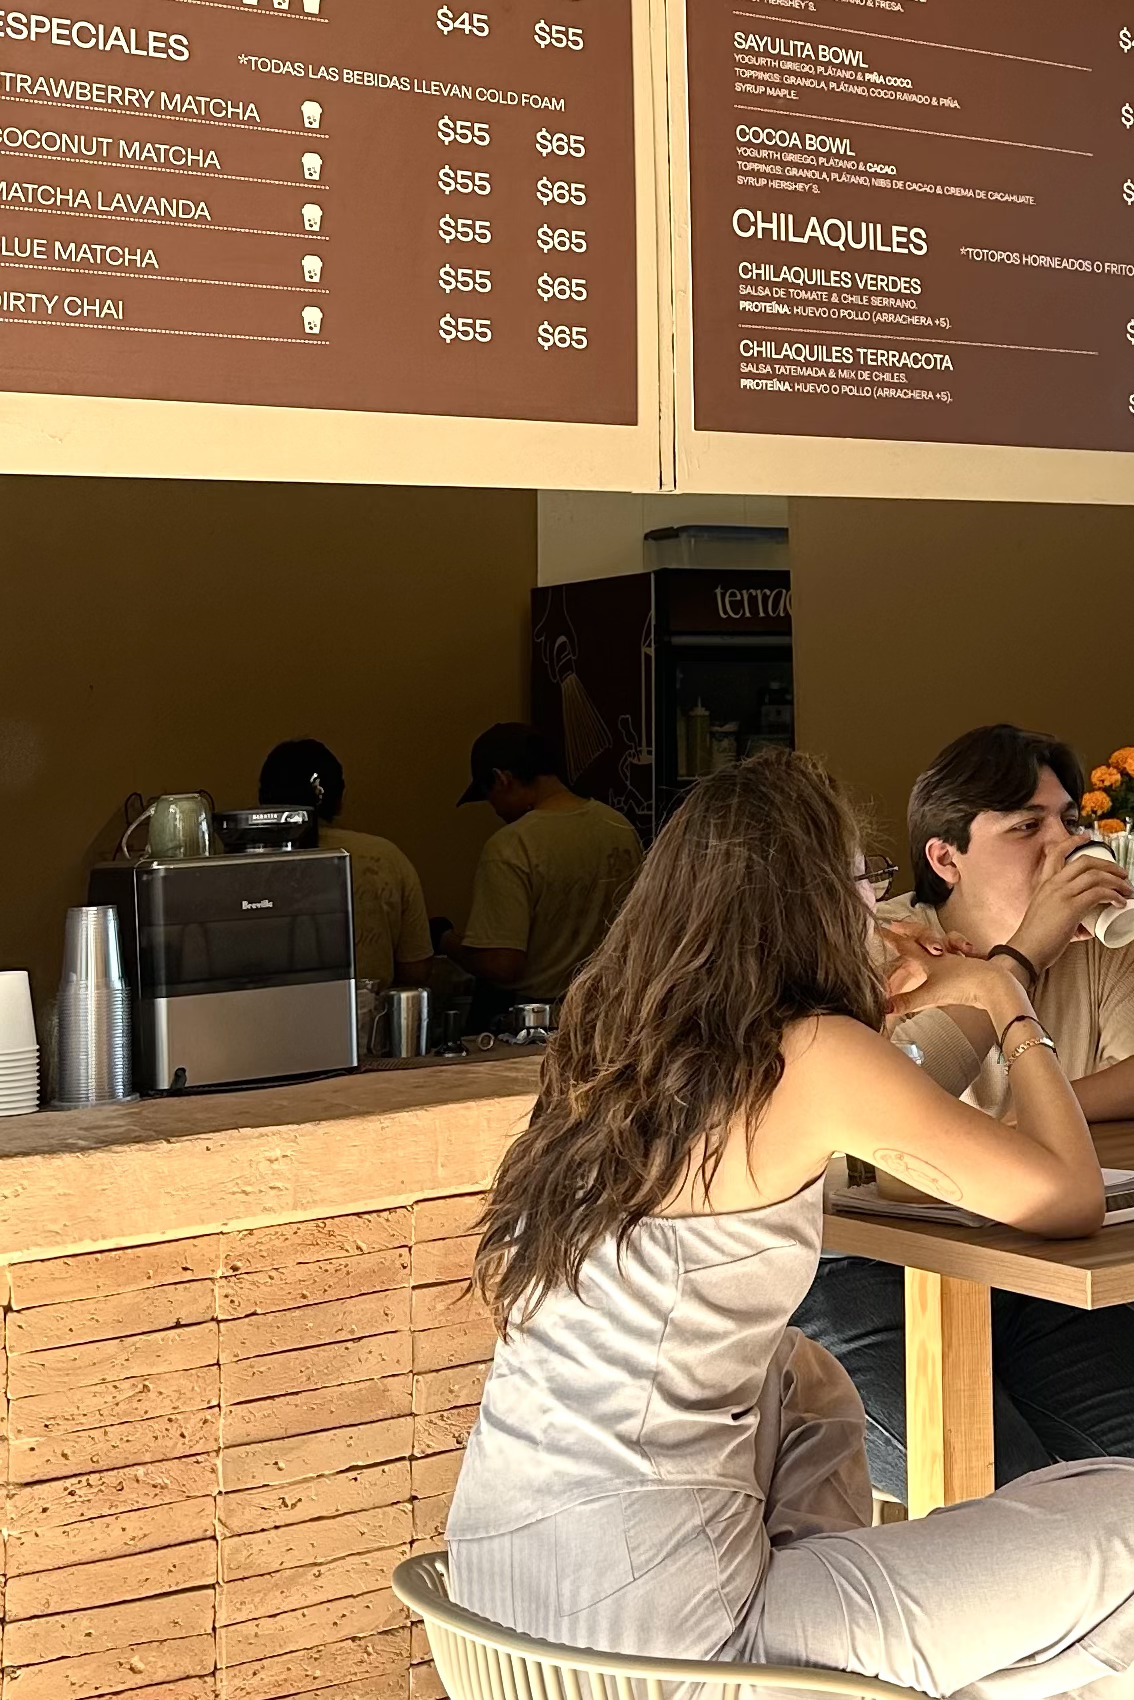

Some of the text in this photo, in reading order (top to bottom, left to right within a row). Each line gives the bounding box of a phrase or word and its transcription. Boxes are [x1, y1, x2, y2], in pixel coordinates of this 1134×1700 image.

[0, 11, 190, 61] SPECIALES
[436, 5, 489, 37] $45
[533, 19, 584, 51] $55
[734, 31, 868, 68] SAYULITA BOWL
[734, 53, 778, 69] YOGURTH
[857, 71, 863, 82] &
[0, 72, 260, 122] TRAWBERRY MATCHA
[309, 64, 339, 84] LAS
[343, 68, 410, 93] BEBIDAS
[414, 78, 472, 100] LLEVAN
[476, 87, 518, 106] COLD
[521, 93, 564, 112] FOAM
[735, 82, 765, 96] SYRUP
[870, 86, 895, 100] COCO
[897, 90, 930, 105] RAYADO
[931, 95, 938, 106] &
[437, 115, 490, 146] $55
[536, 128, 586, 158] $65
[736, 124, 855, 156] COCOA BOWL
[0, 127, 221, 169] OCONUT MATCHA
[736, 146, 781, 161] YOGURTH
[858, 161, 865, 171] &
[437, 165, 491, 196] $55
[536, 177, 587, 207] $65
[737, 176, 767, 188] SYRUP
[872, 176, 891, 188] NIBS
[893, 178, 904, 190] DE
[905, 180, 934, 193] CACAO
[936, 183, 942, 194] &
[944, 186, 974, 200] CREMA
[976, 189, 987, 201] DE
[0, 182, 211, 221] ATCHA LAVANDA
[438, 214, 492, 245] $55
[536, 226, 587, 254] $65
[732, 208, 928, 256] CHILAQUILES
[1, 236, 158, 269] LUE MATCHA
[1022, 253, 1092, 272] HORNEADOS
[1094, 261, 1102, 273] O
[438, 264, 493, 294] $55
[536, 273, 588, 303] $65
[738, 261, 922, 295] CHILAQUILES VERDES
[0, 291, 124, 319] IRTY CHAI
[739, 284, 917, 310] SALSA DE TOMATE & CHILE SERRANO.
[438, 314, 493, 345] $55
[794, 305, 828, 319] HUEVO
[830, 308, 838, 320] O
[840, 309, 870, 323] POLLO
[872, 311, 933, 328] (ARRACHERA
[537, 322, 588, 351] $65
[740, 339, 953, 371] CHILAQUILES TERRACOTA
[740, 363, 908, 384] SALSA TATEMADA & MIX DE CHILES.
[795, 382, 829, 395] HUEVO
[831, 384, 839, 396] O
[841, 385, 871, 398] POLLO
[873, 387, 934, 403] (ARRACHERA
